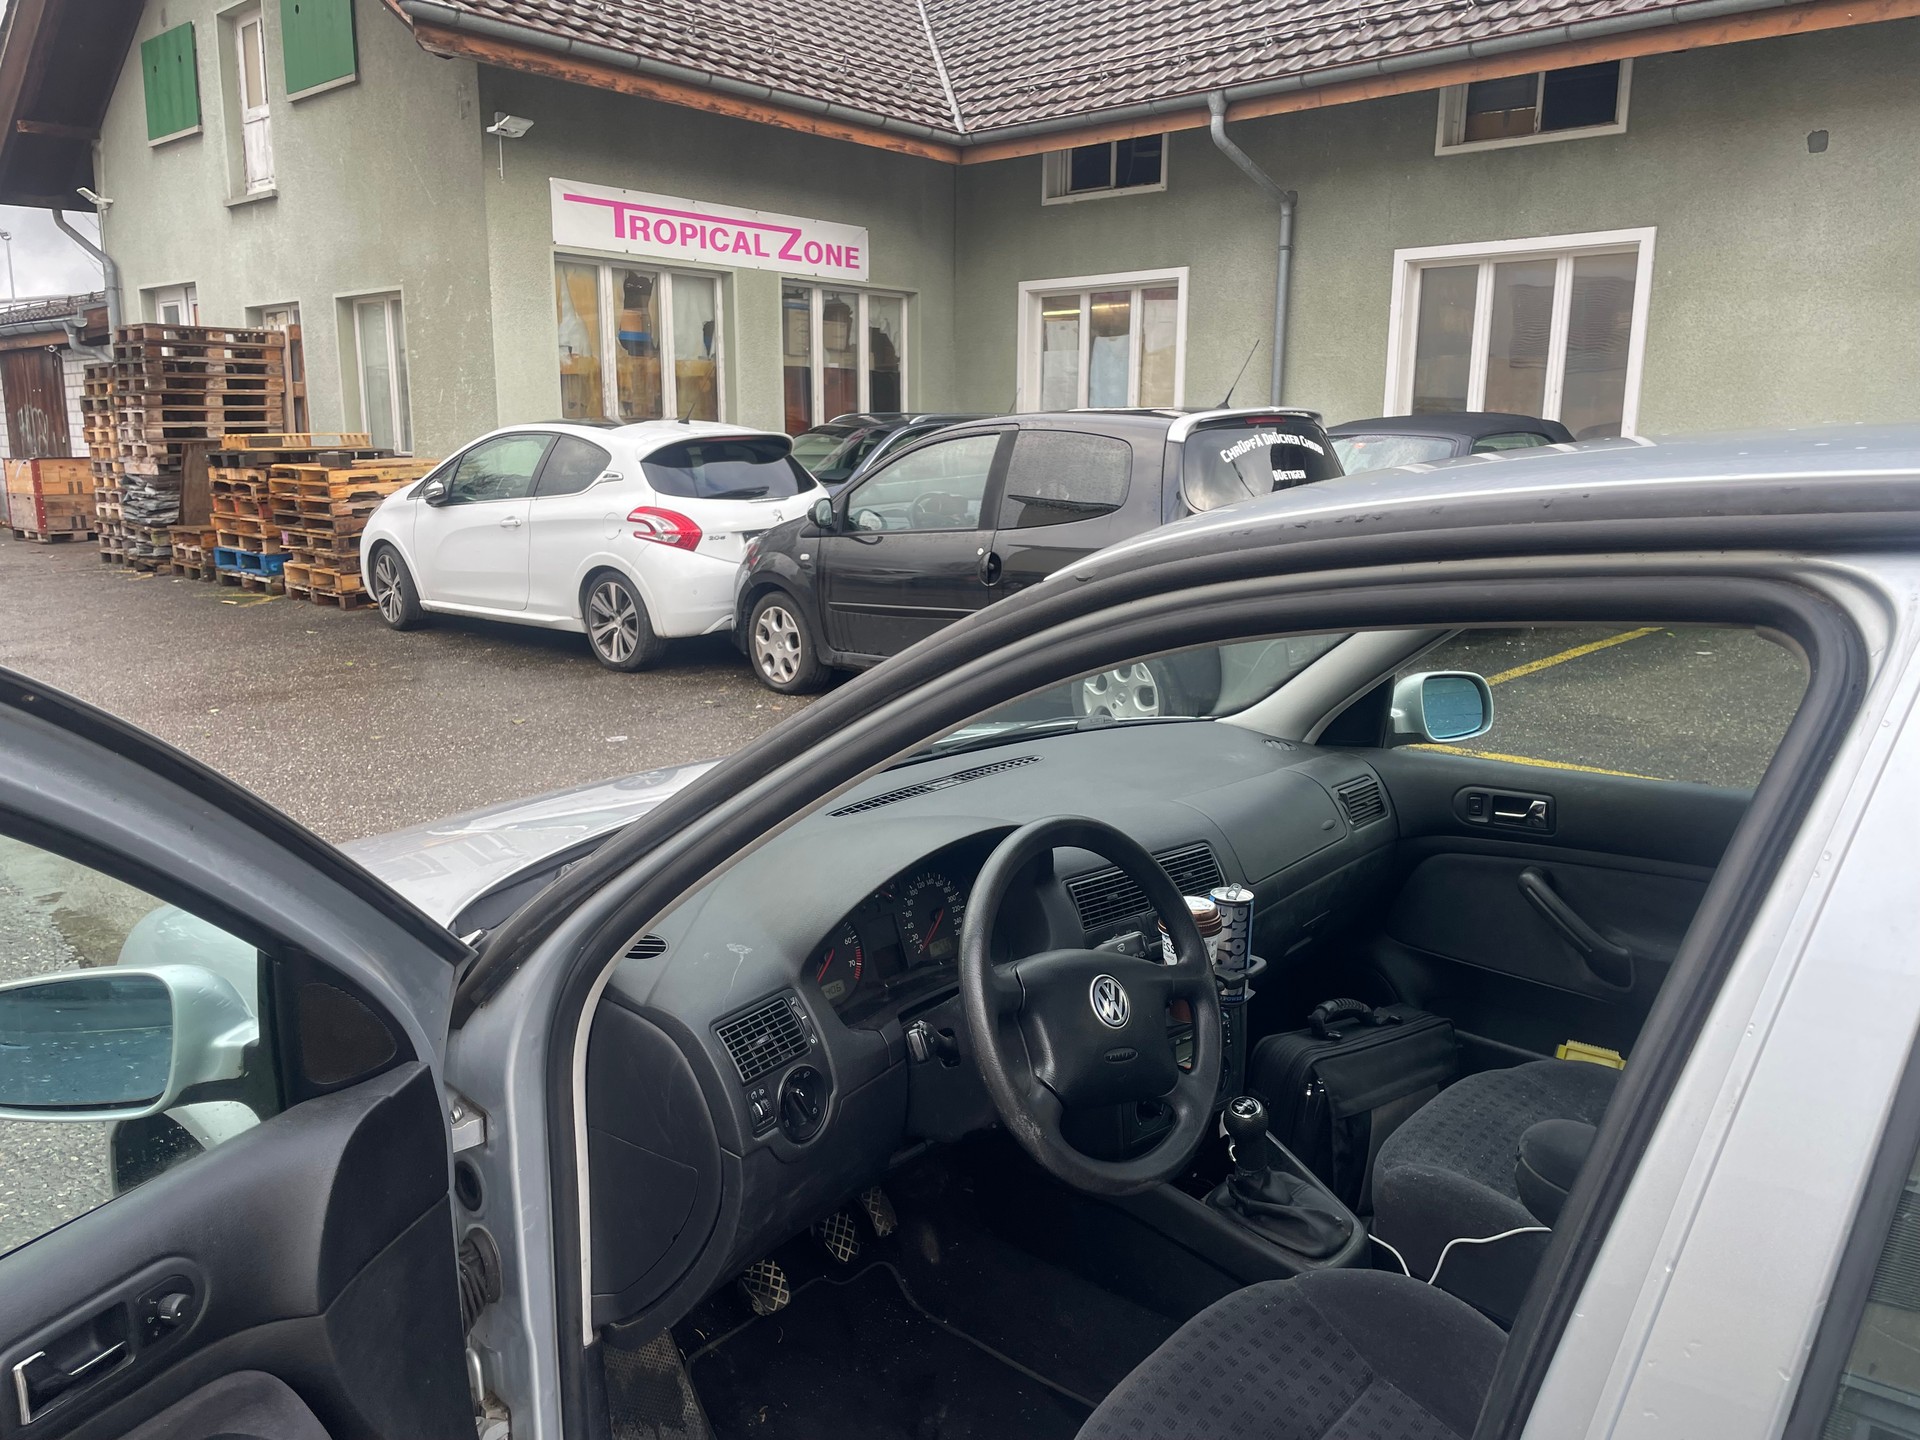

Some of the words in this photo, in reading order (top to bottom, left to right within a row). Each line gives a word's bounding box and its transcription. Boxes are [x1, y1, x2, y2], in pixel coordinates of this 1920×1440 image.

[563, 193, 770, 258] TROPICAL
[778, 227, 860, 269] ZONE
[844, 937, 852, 945] 60
[848, 959, 856, 968] 70
